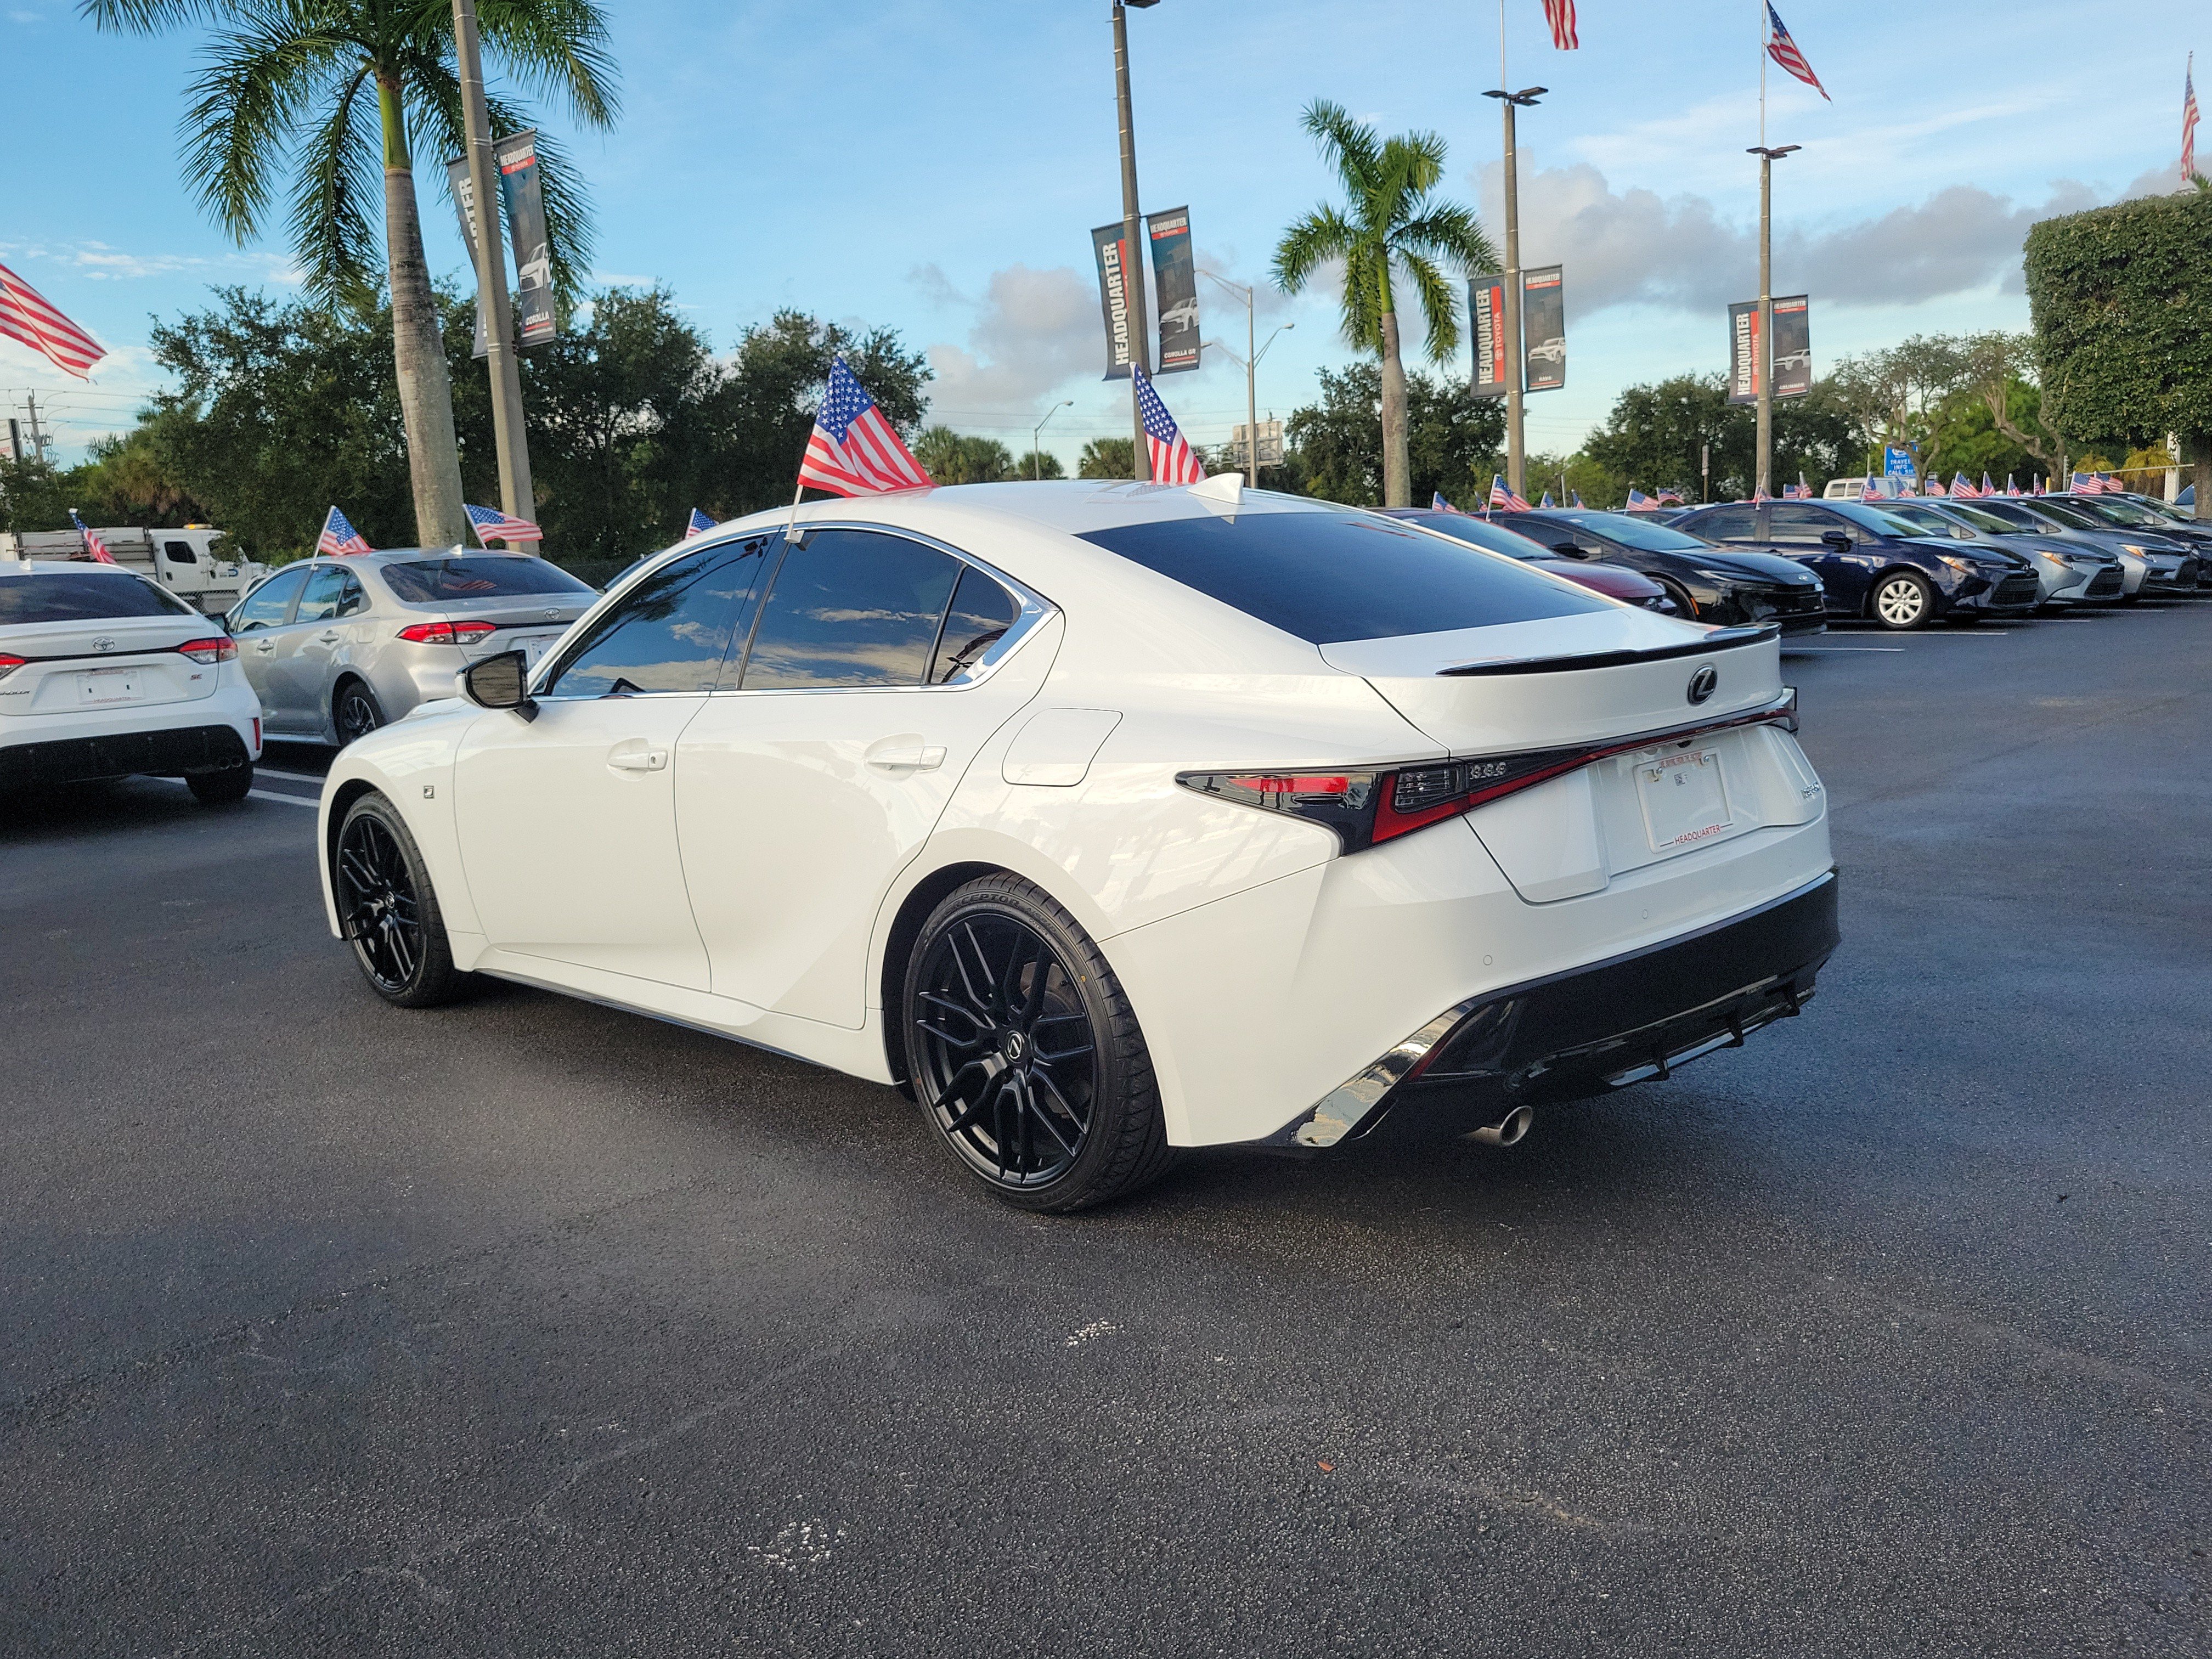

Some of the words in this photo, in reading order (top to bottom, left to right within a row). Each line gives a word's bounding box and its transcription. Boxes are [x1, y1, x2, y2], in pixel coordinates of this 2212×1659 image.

[526, 311, 549, 326] COROLLA
[1103, 242, 1129, 365] HEADQUARTER
[1476, 289, 1493, 385] HEADQUARTER
[1494, 312, 1503, 347] TOYOTA
[1164, 350, 1187, 359] COROLLA
[1736, 313, 1752, 396] HEADQUARTER
[1674, 825, 1720, 845] HEADQUARTER
